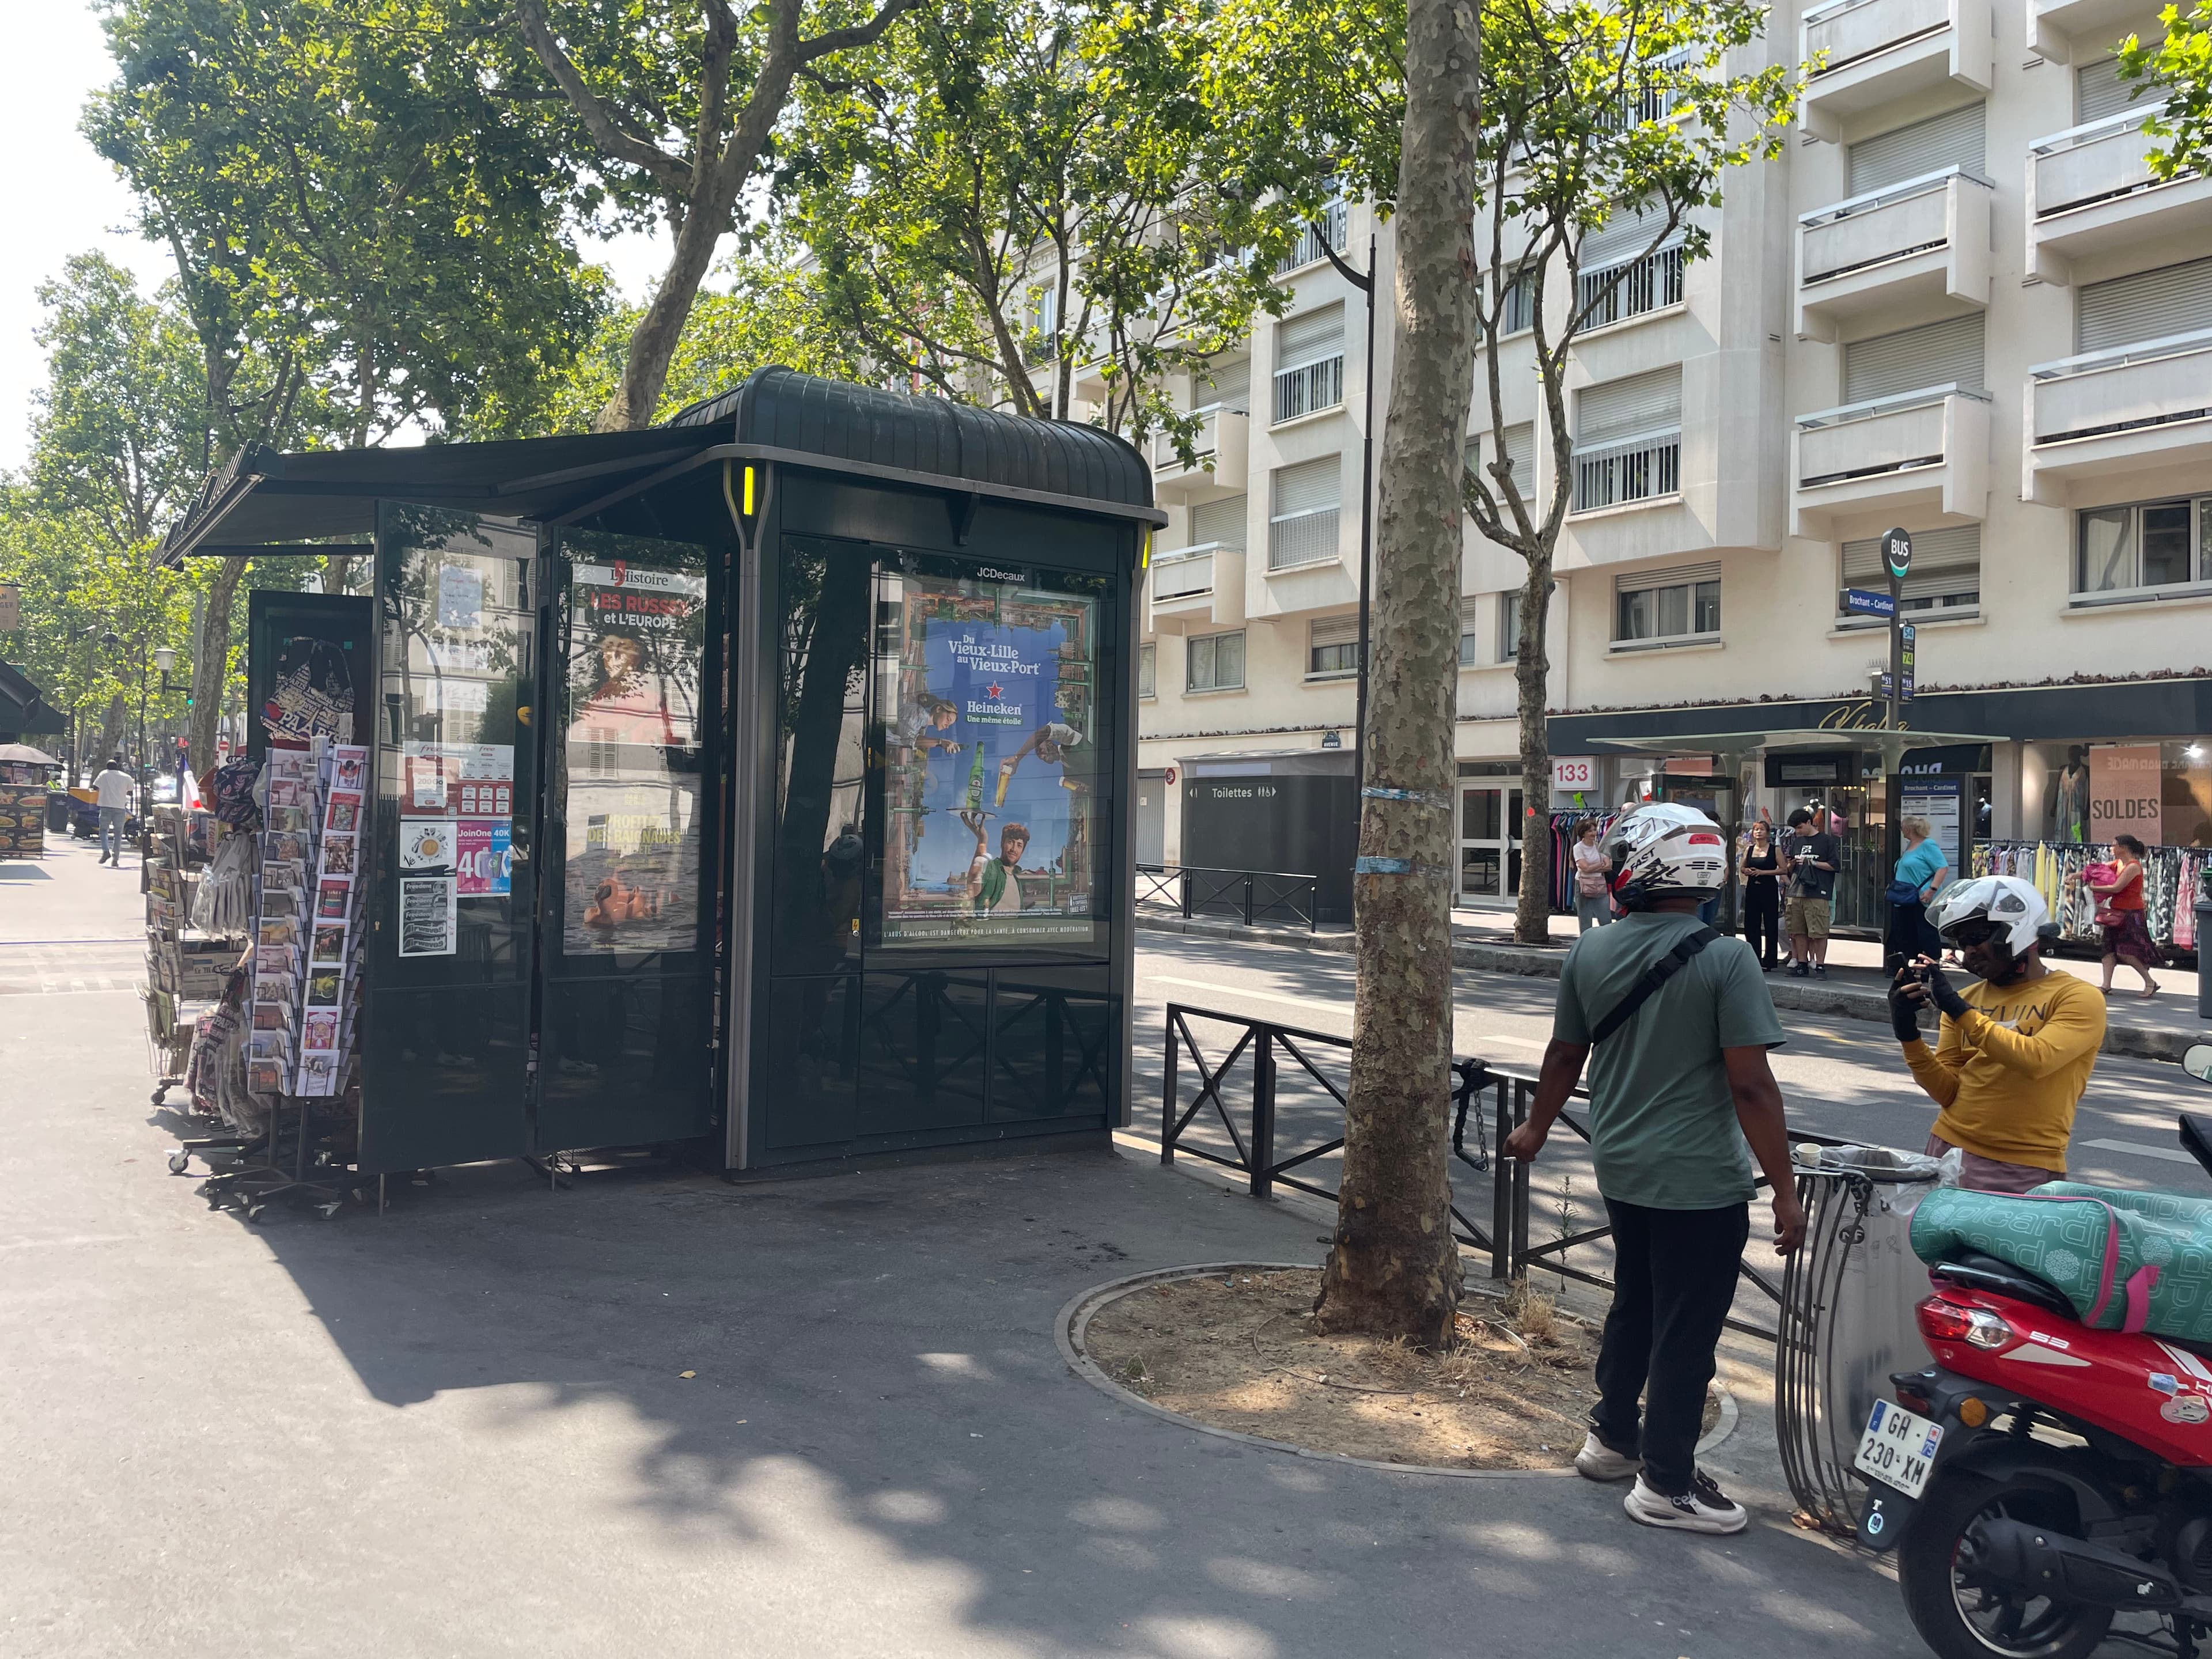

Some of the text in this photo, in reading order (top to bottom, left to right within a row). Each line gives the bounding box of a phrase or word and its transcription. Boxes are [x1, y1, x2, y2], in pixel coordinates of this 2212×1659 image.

[1891, 539, 1908, 556] BUS
[610, 566, 668, 586] L'Histoire
[976, 567, 1025, 582] JCDecaux
[591, 592, 622, 610] LES
[1849, 594, 1870, 607] Brochant
[1874, 599, 1893, 611] Cardinet
[604, 612, 677, 630] et L'EUROPE
[963, 634, 975, 644] Du
[1904, 628, 1913, 638] 54
[948, 640, 1018, 659] Vieux-Lille
[957, 656, 968, 664] au
[1903, 653, 1912, 664] 74
[967, 700, 1022, 715] Heineken
[967, 715, 1022, 725] Une même étoile
[420, 744, 443, 753] free
[1556, 764, 1588, 782] 133
[1211, 787, 1252, 798] Toilettes
[2092, 798, 2158, 819] SOLDES
[458, 829, 510, 837] JoinOne 40K
[614, 828, 681, 844] BAIGNADES
[1630, 847, 1656, 872] FAST
[1946, 1206, 2095, 1248] picard
[1888, 1412, 1912, 1441] GH
[1923, 1441, 1936, 1457] 75
